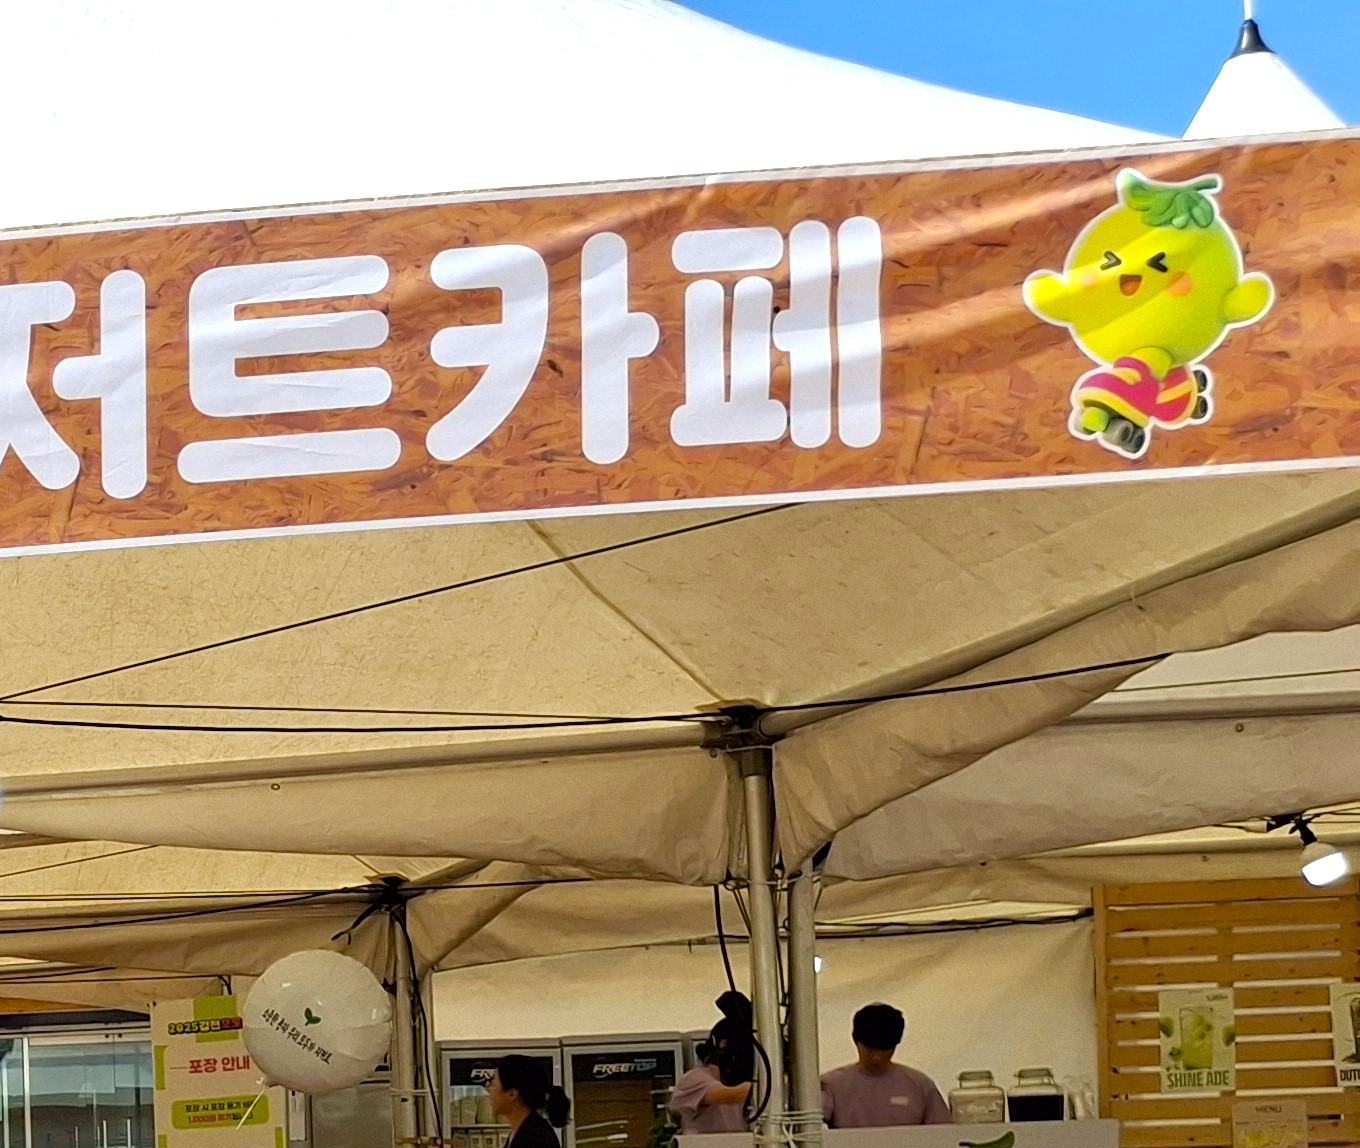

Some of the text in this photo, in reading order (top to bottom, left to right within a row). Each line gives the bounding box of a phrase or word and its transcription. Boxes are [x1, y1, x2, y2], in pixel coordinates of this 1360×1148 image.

[167, 1016, 244, 1035] 2025김천포도
[188, 1055, 251, 1075] 포장 안내
[592, 1062, 658, 1075] FREETOP
[1166, 1070, 1230, 1088] SHINE ADE
